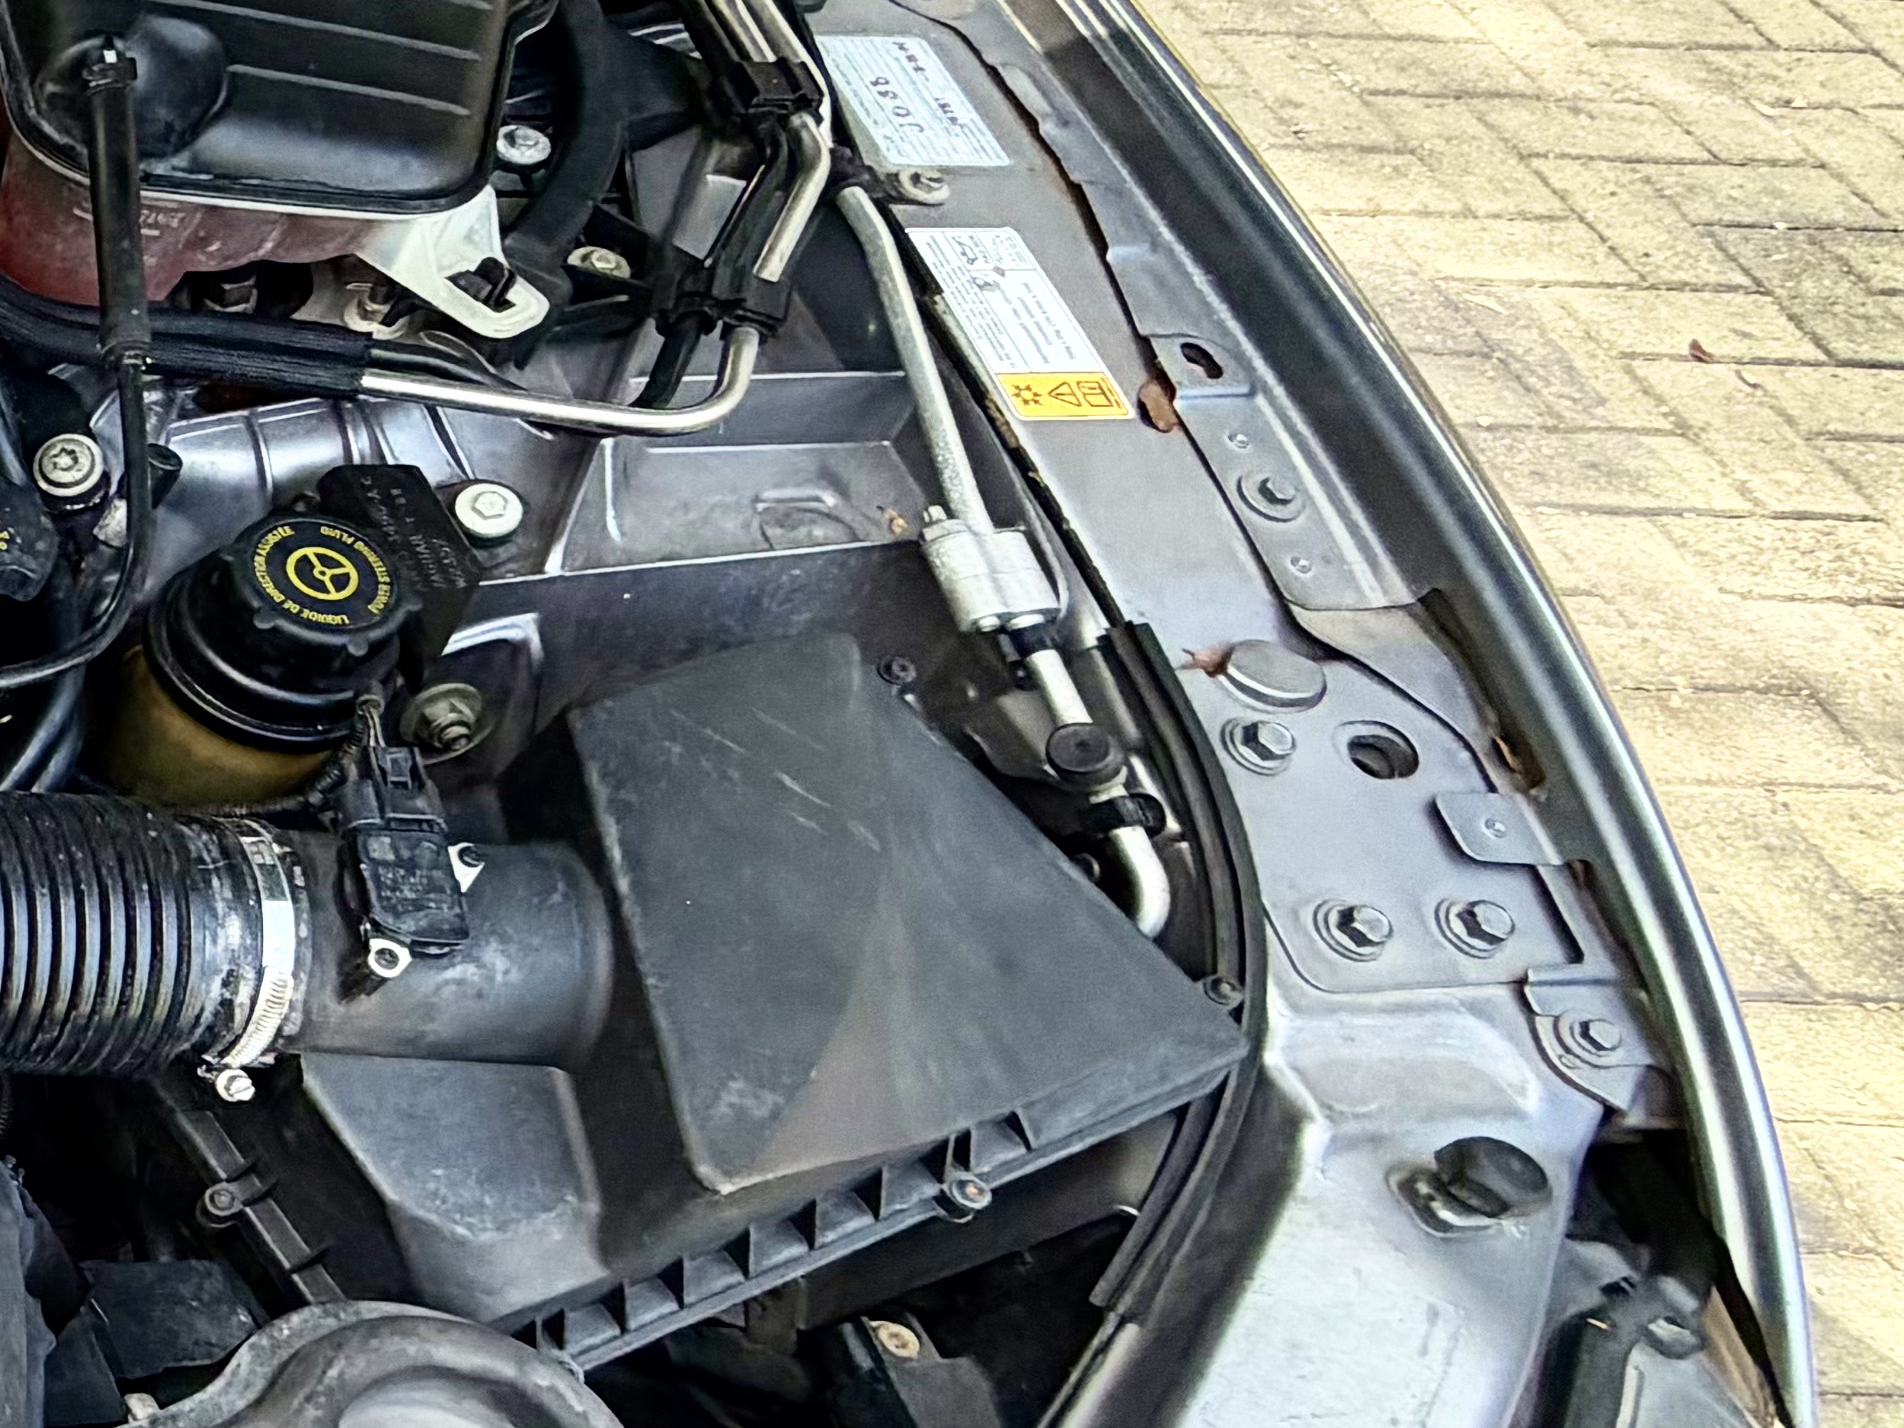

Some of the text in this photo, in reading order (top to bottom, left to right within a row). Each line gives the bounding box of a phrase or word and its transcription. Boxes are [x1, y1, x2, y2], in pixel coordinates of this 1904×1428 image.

[320, 525, 355, 545] FLUID
[353, 541, 391, 583] STEERING
[254, 555, 286, 604] DIRECTION
[282, 598, 301, 615] DE
[298, 607, 349, 626] LIQUIDE
